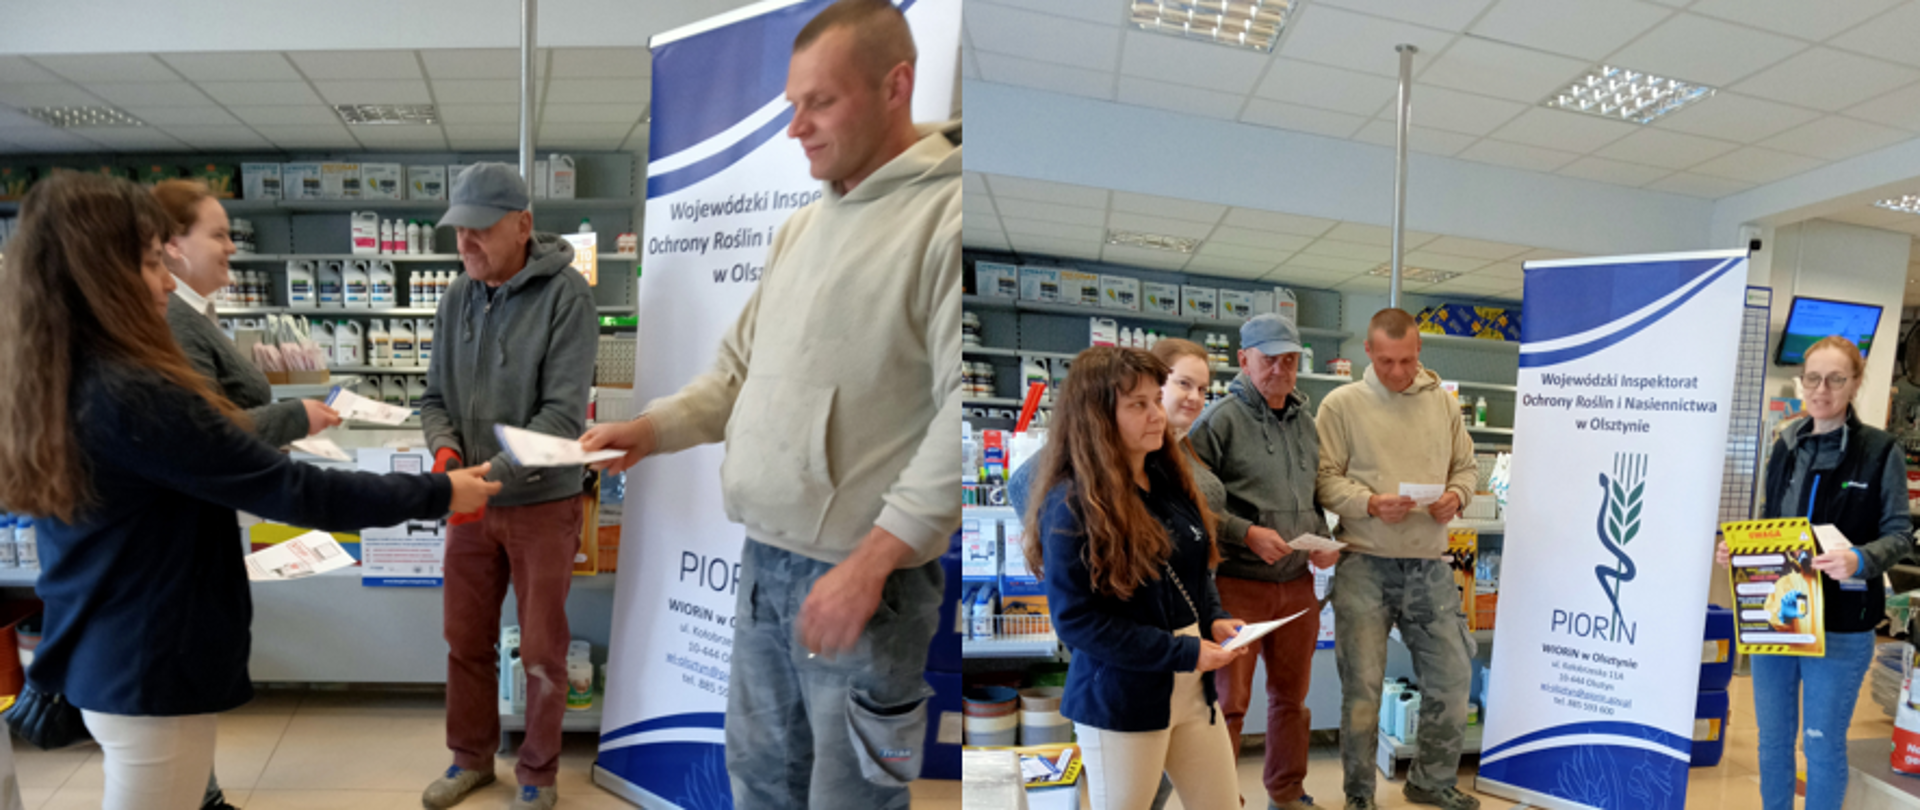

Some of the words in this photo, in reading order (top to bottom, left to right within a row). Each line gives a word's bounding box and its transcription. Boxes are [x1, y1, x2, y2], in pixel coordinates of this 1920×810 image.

[670, 191, 768, 222] Wojewódzki
[649, 234, 710, 255] Ochrony
[713, 228, 763, 250] Roślin
[767, 226, 772, 246] i
[713, 270, 728, 283] w
[1541, 373, 1618, 388] Wojewódzki
[1620, 374, 1698, 390] Inspektorat
[1522, 393, 1573, 410] Ochrony
[1575, 395, 1614, 409] Roślin
[1616, 396, 1621, 409] i
[1625, 397, 1717, 413] Nasiennictwa
[1575, 419, 1588, 430] w
[1590, 417, 1650, 434] Olsztynie
[1551, 609, 1637, 645] PIORIN
